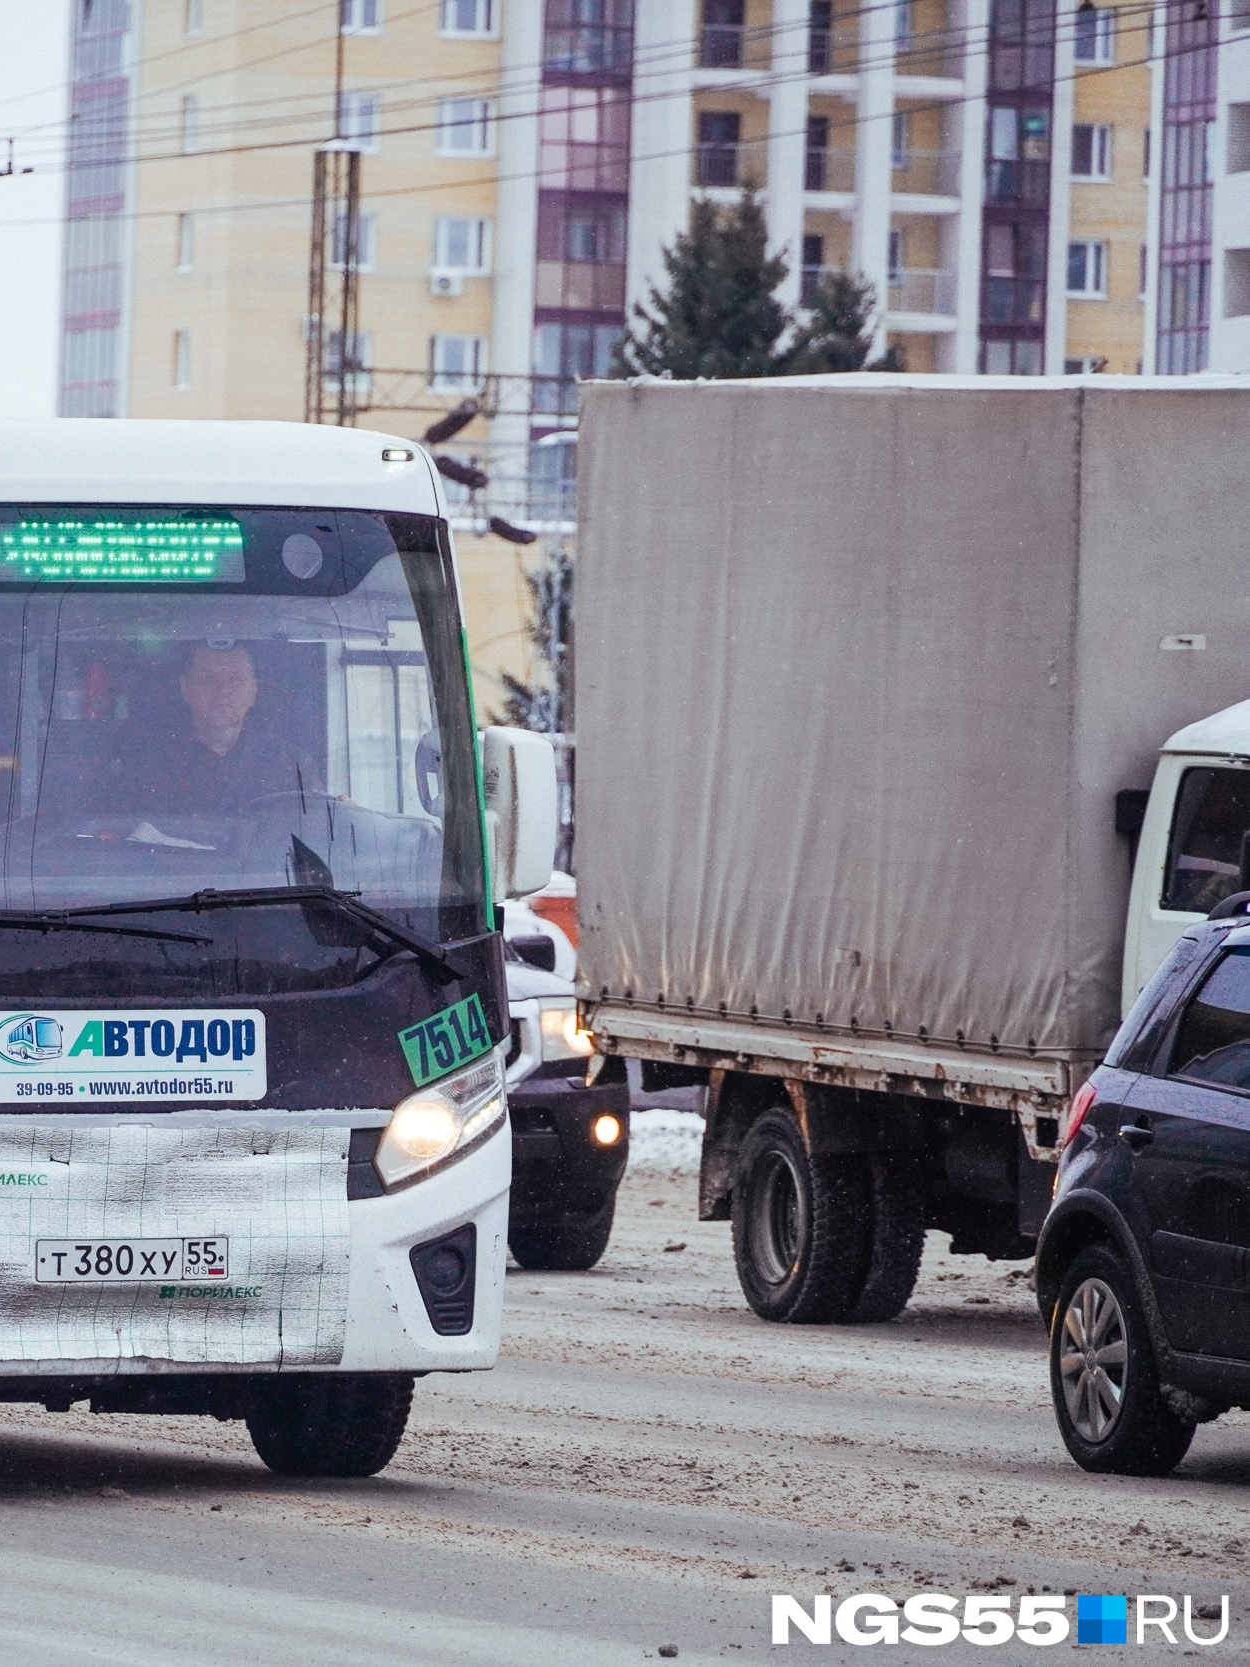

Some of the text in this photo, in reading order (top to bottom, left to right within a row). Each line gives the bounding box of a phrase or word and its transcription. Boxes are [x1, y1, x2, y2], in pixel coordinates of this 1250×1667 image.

[403, 998, 488, 1079] 7514
[16, 1078, 233, 1096] 39-09-95 www.avtodor55.ru
[186, 1241, 218, 1266] 55
[184, 1265, 207, 1275] RUS
[178, 1285, 263, 1298] ПОРИЛЕКС
